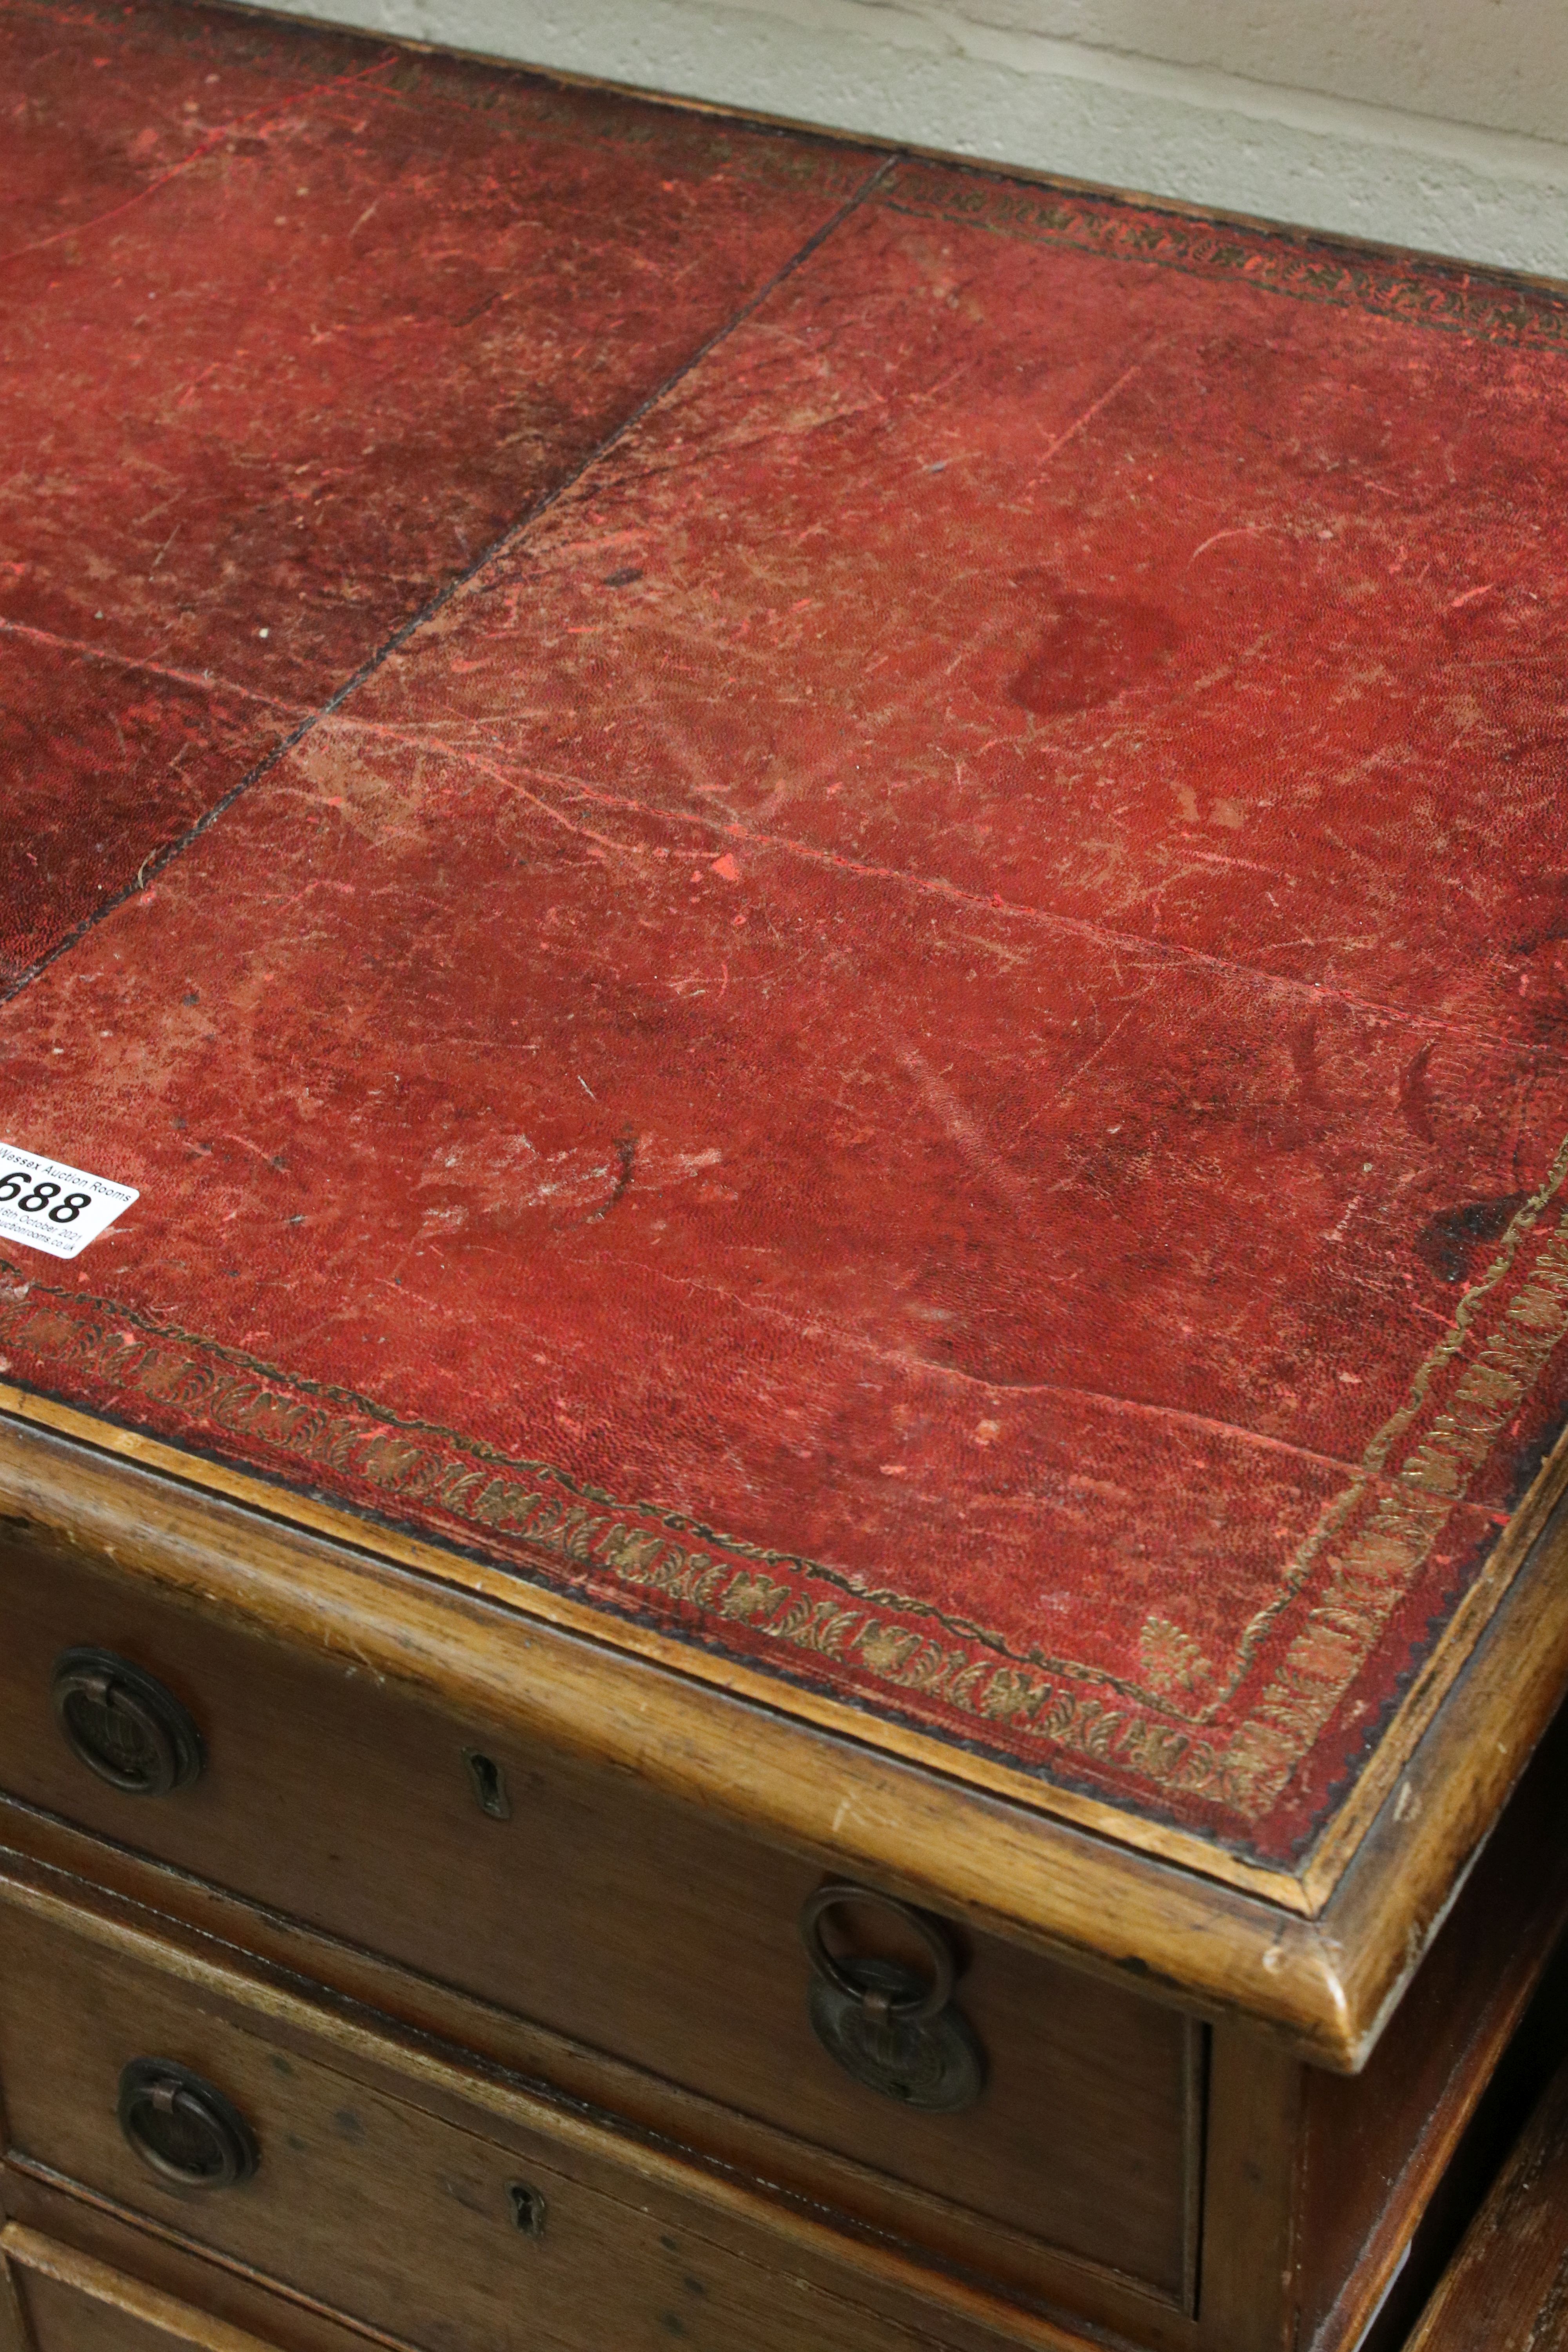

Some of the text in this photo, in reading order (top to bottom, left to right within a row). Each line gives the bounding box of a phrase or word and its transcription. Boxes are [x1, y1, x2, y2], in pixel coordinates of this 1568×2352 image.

[0, 1148, 131, 1202] Wessex Auction Rooms
[0, 1172, 92, 1223] 688
[0, 1219, 76, 1251] uctionrooms.co.uk
[19, 1215, 58, 1233] October
[58, 1229, 83, 1242] 2021
